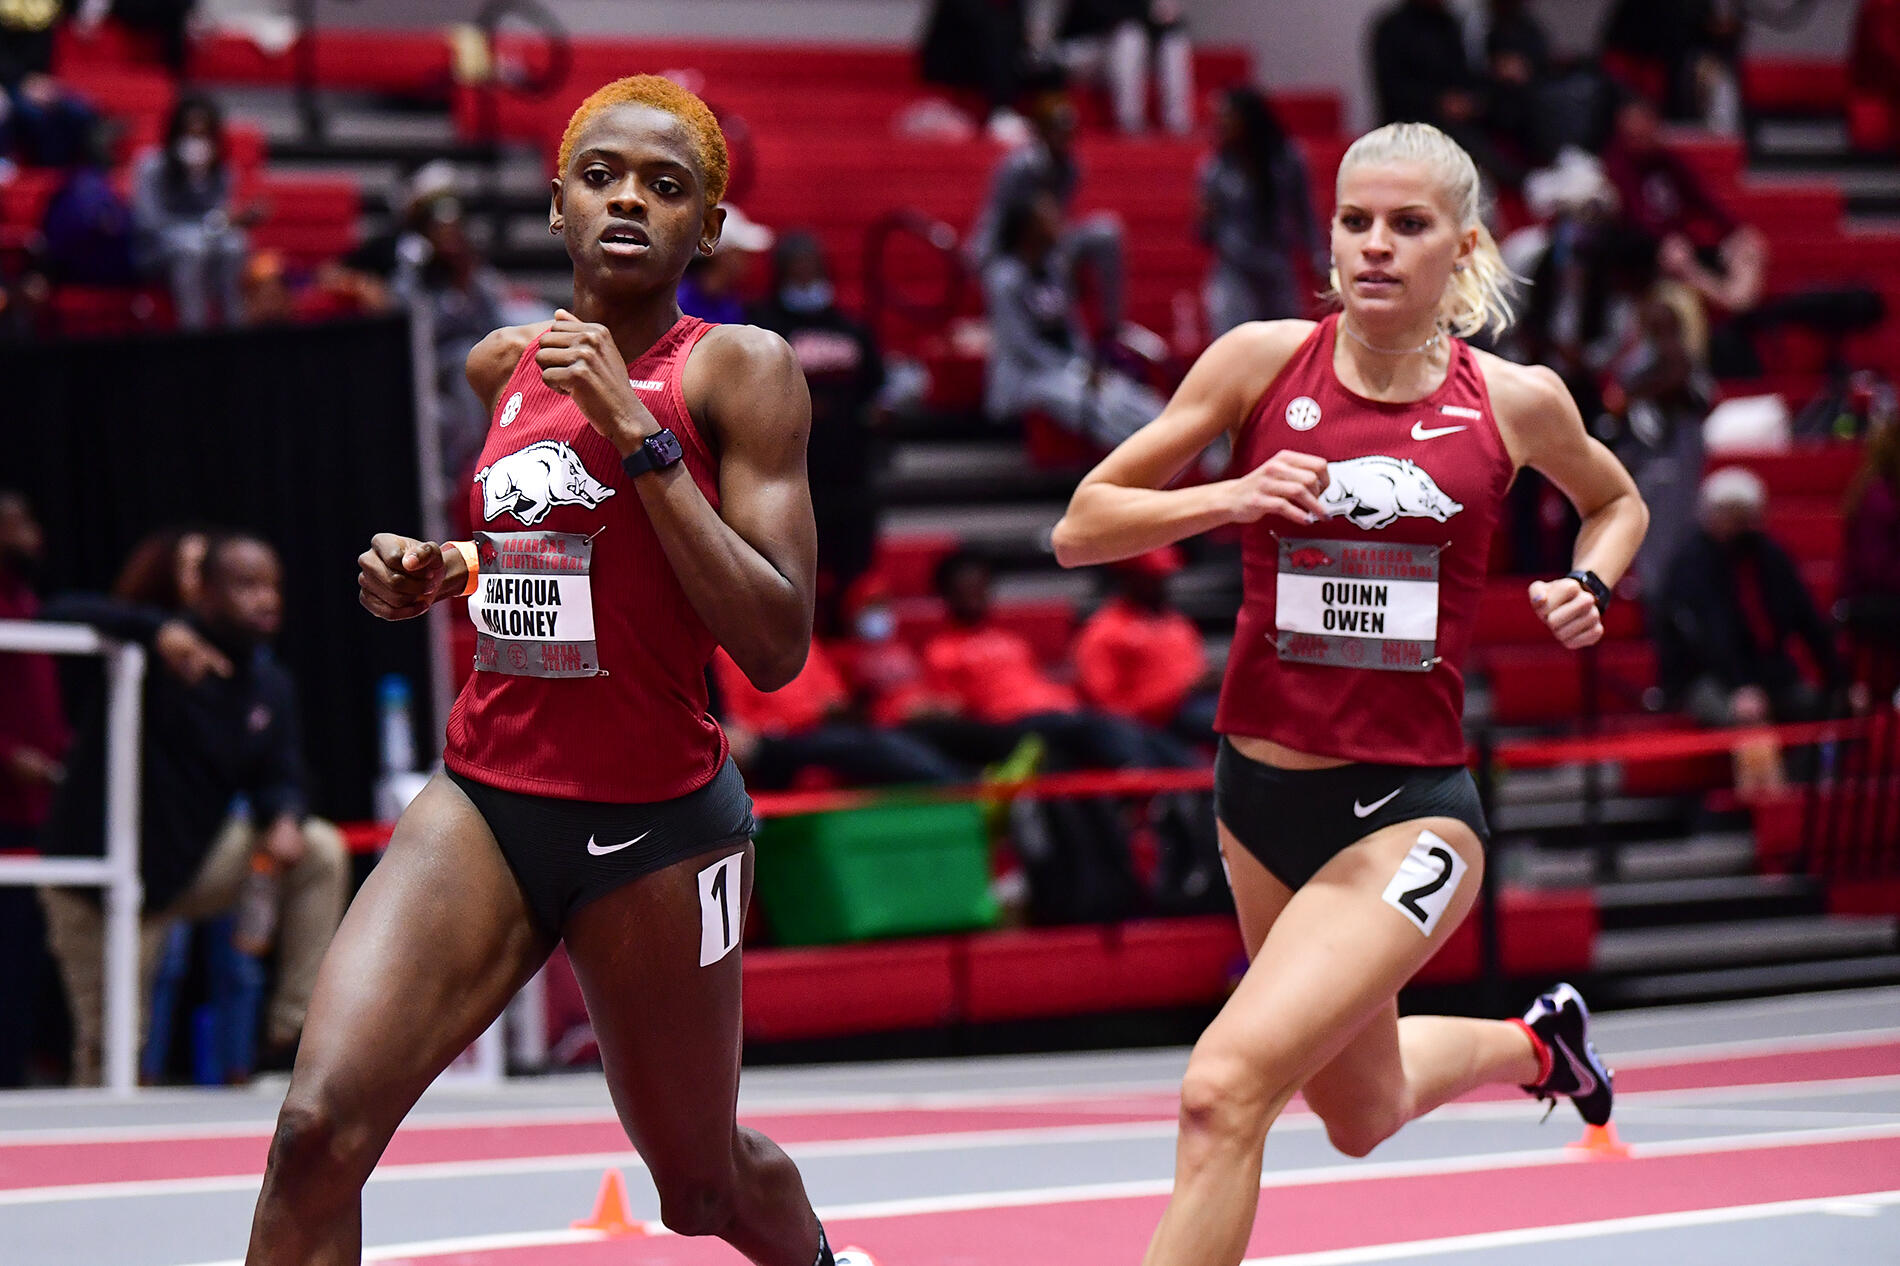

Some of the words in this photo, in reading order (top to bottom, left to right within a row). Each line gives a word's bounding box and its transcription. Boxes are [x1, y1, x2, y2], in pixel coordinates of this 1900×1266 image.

[629, 379, 663, 391] UALITY
[503, 539, 566, 553] ARKANSAS
[502, 554, 584, 570] INVITATIONAL
[1322, 582, 1388, 606] QUINN
[482, 608, 558, 637] MALONEY
[1323, 609, 1385, 633] OWEN
[1398, 847, 1453, 924] 2
[711, 864, 730, 950] 1
